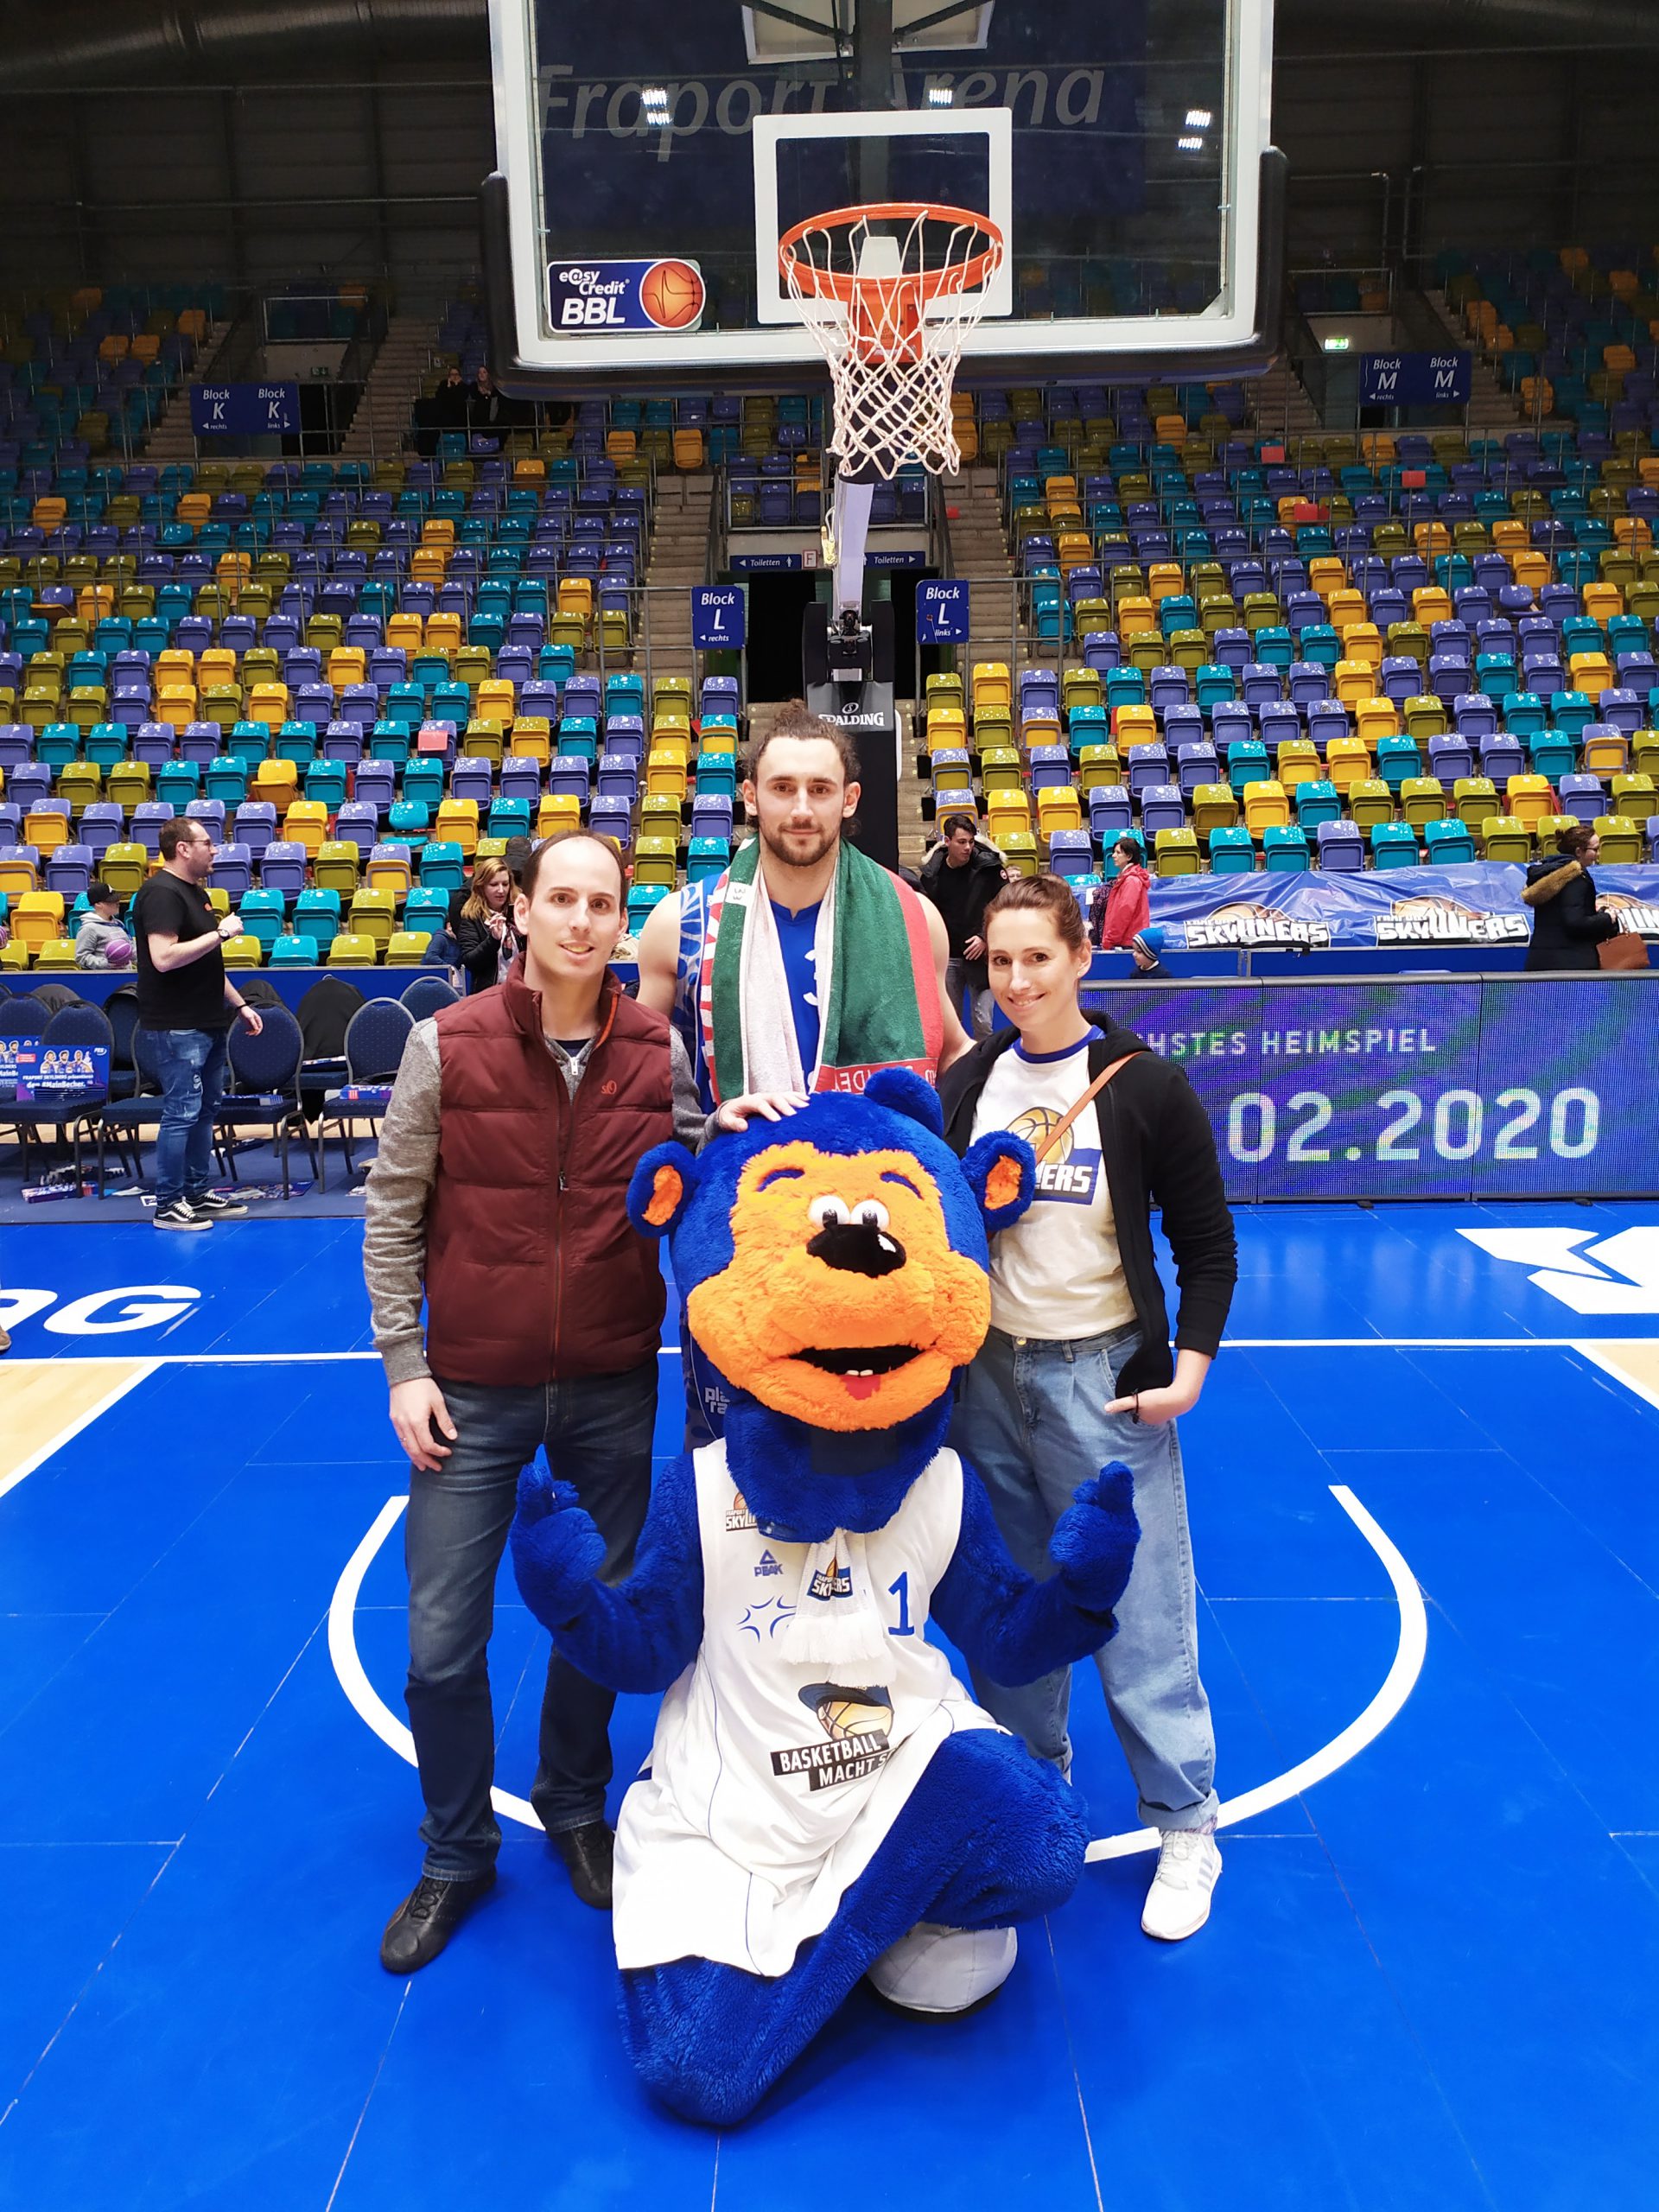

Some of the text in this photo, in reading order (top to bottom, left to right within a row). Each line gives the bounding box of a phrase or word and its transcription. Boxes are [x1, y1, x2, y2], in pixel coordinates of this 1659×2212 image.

[561, 296, 626, 326] BBL
[1373, 358, 1402, 370] Block
[1430, 356, 1459, 368] Block
[1376, 372, 1398, 391] M
[1434, 370, 1455, 389] M
[203, 389, 230, 400] Block
[257, 387, 285, 398] Block
[213, 402, 225, 420] K
[268, 401, 280, 419] K
[750, 558, 781, 568] Toiletten
[874, 556, 905, 564] Toiletten
[701, 592, 735, 606] Block
[925, 587, 960, 600] Block
[714, 608, 726, 630] L
[938, 603, 950, 625] L
[935, 628, 951, 637] links
[1261, 1028, 1437, 1054] HEIMSPIEL
[753, 1563, 784, 1577] PEAK
[887, 1571, 915, 1637] 1
[779, 1733, 881, 1772] BASKETBALL
[818, 1758, 875, 1788] MACHT
